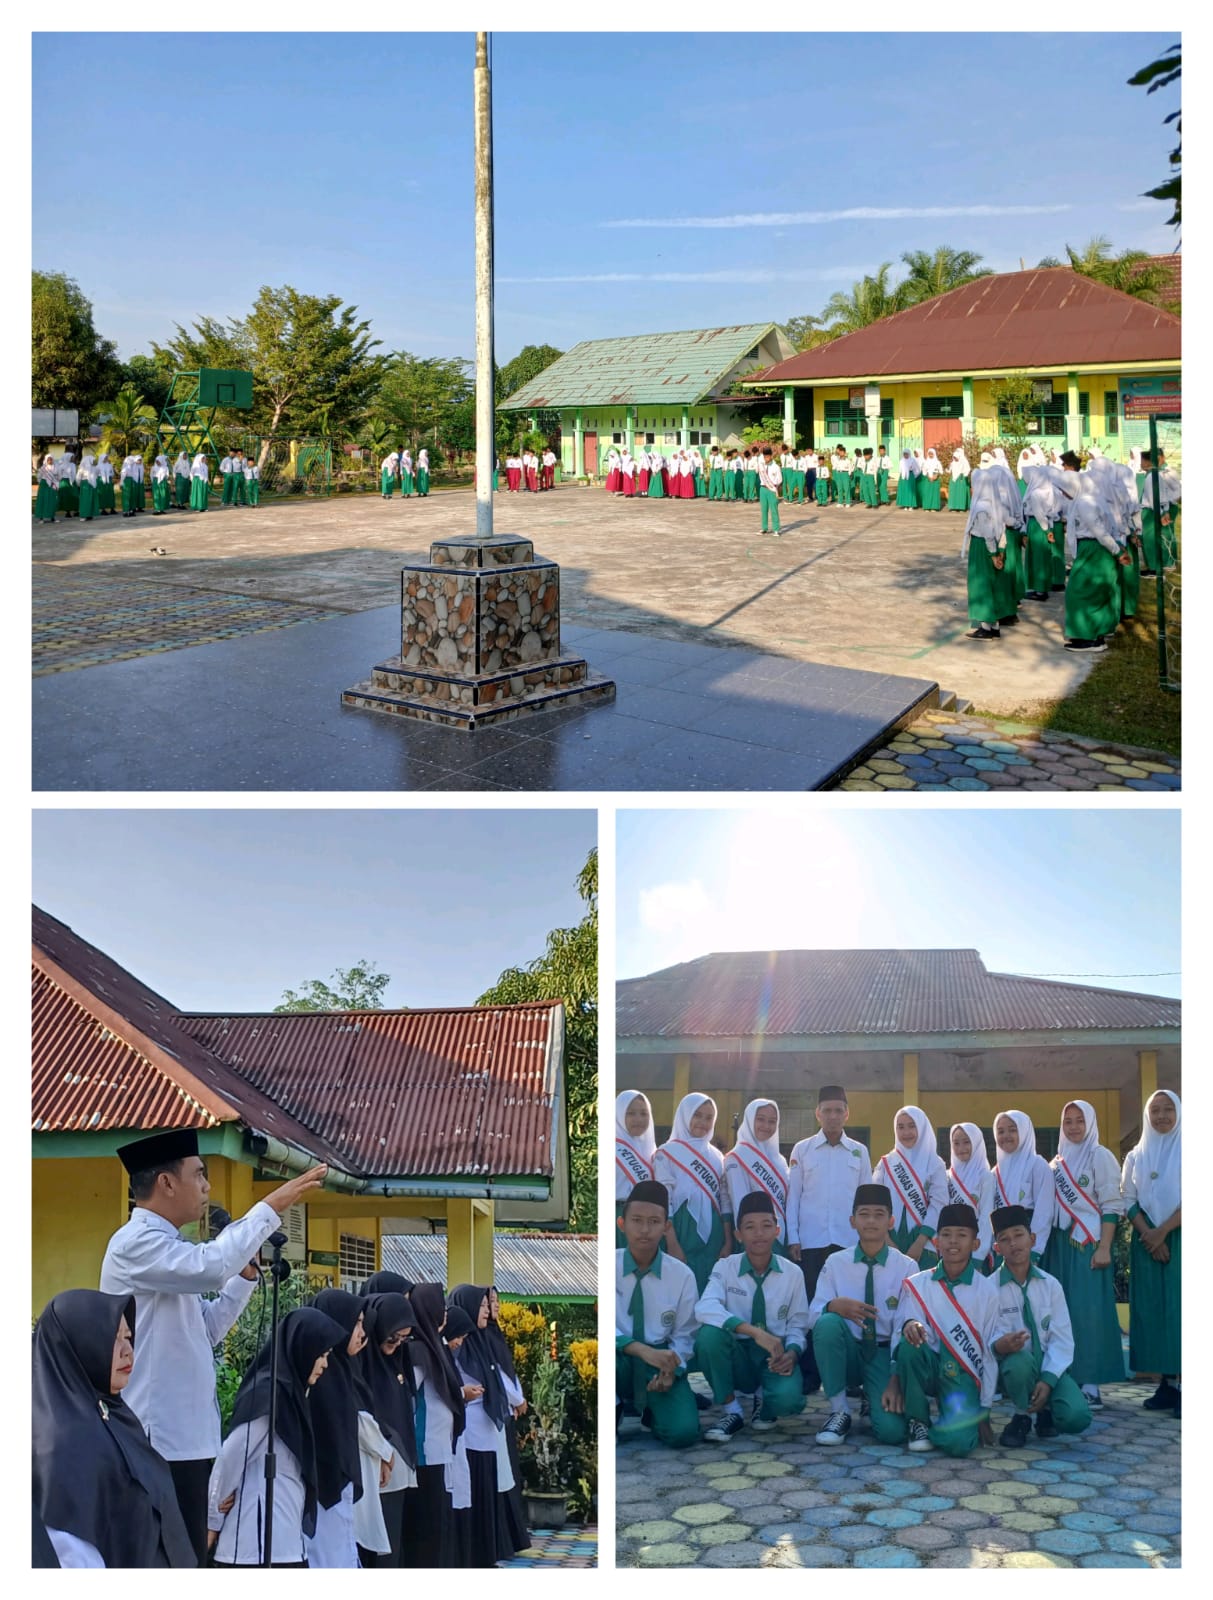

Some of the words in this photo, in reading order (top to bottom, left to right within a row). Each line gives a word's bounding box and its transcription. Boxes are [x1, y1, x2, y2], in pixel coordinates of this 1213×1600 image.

[690, 1159, 719, 1192] PETUGAS
[751, 1161, 780, 1193] PETUGAS
[893, 1162, 914, 1191] PETUGAS
[1056, 1173, 1079, 1205] UPACARA
[950, 1323, 982, 1369] PETUGAS
